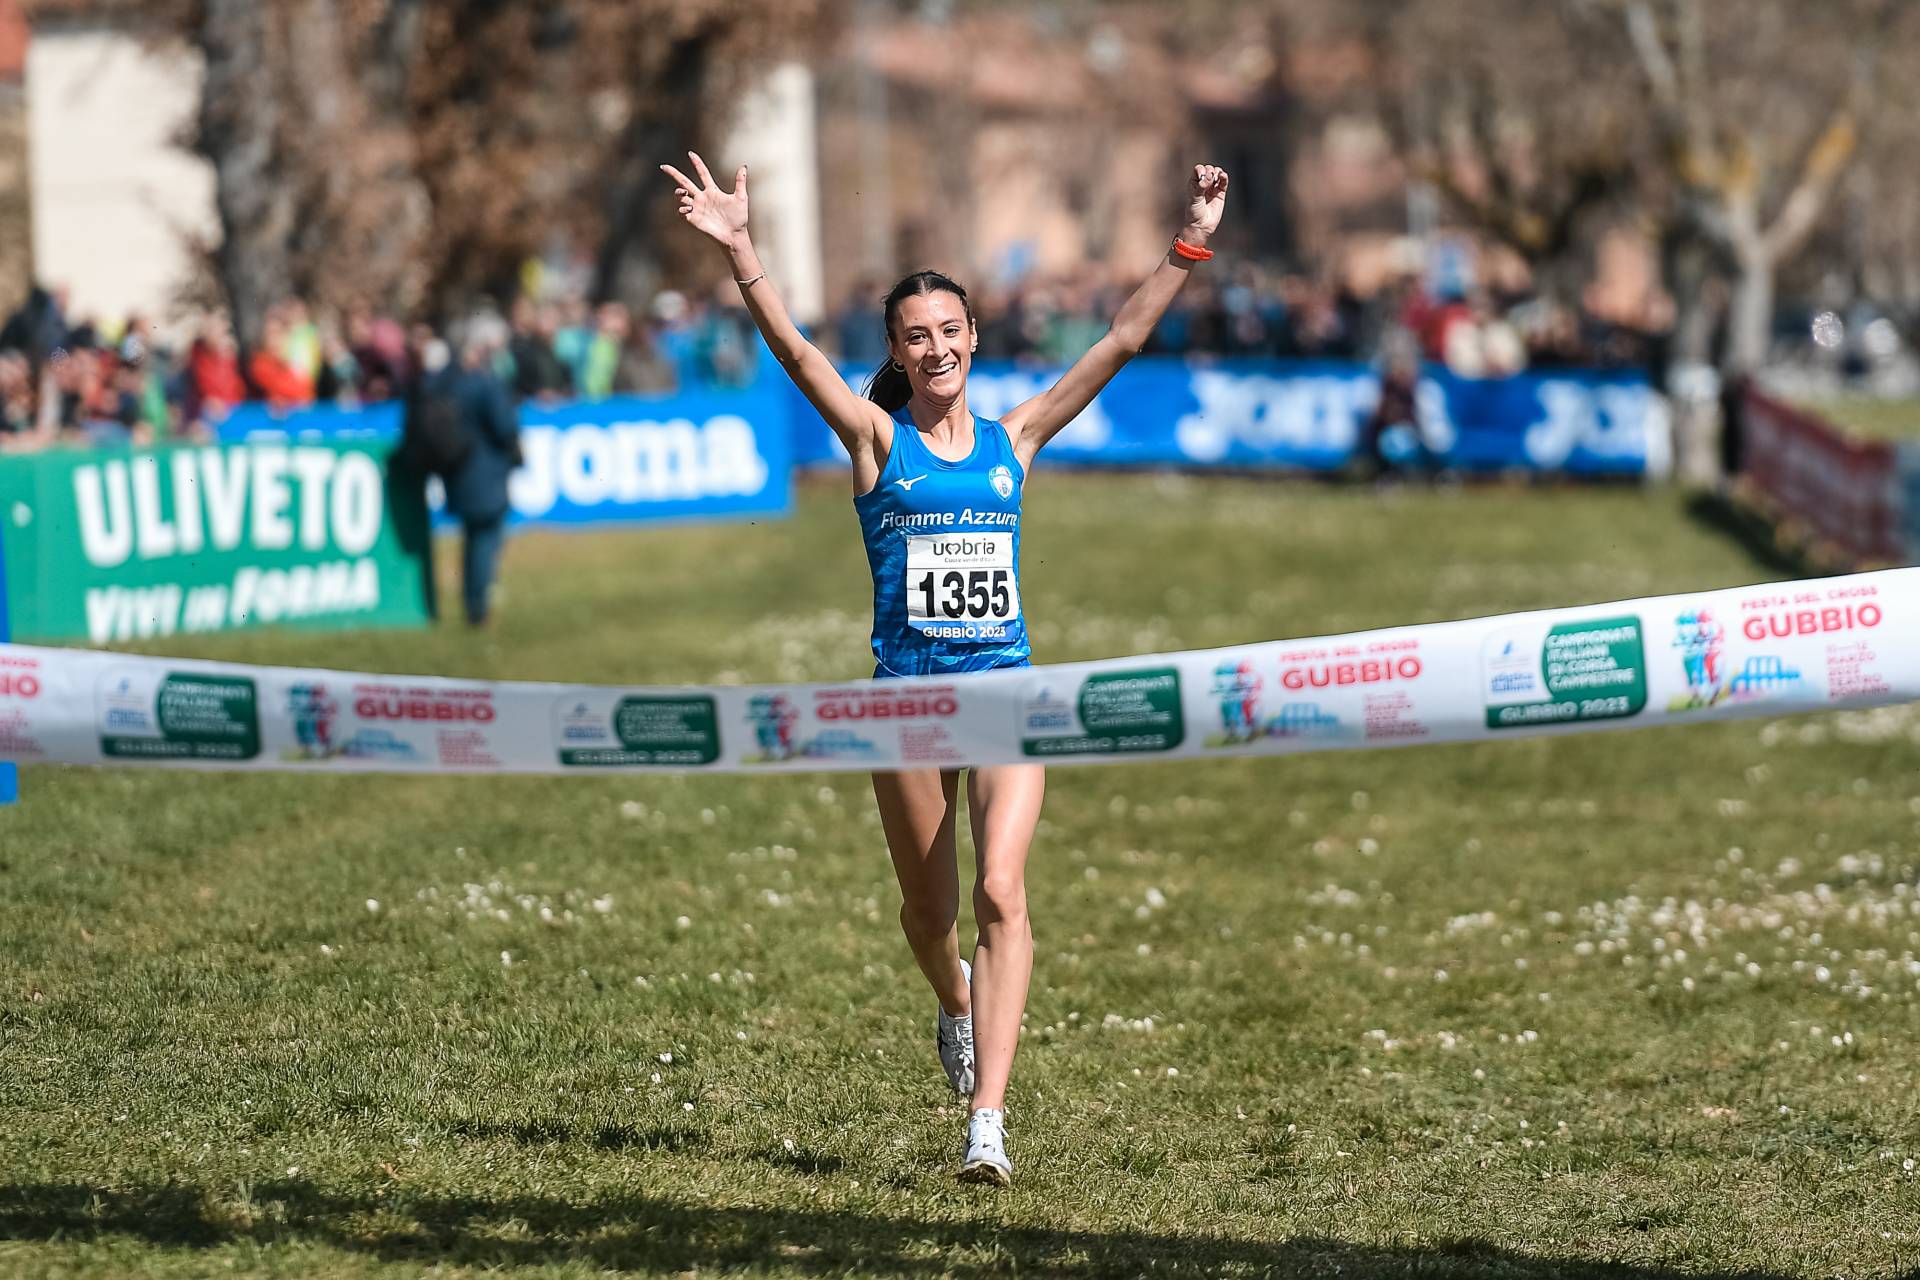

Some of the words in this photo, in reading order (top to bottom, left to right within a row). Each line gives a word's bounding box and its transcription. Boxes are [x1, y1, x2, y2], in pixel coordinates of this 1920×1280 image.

[73, 445, 383, 567] ULIVETO
[881, 512, 954, 529] Fiamme
[919, 570, 1010, 618] 1355
[1793, 592, 1821, 604] DEL
[923, 626, 976, 638] GUBBIO
[980, 626, 1006, 638] 2023
[1743, 603, 1882, 641] GUBBIO
[1281, 656, 1421, 690] GUBBIO
[355, 699, 495, 722] GUBBIO
[816, 697, 959, 720] GUBBIO
[1500, 702, 1578, 722] GUBBIO
[1580, 696, 1630, 714] 2023
